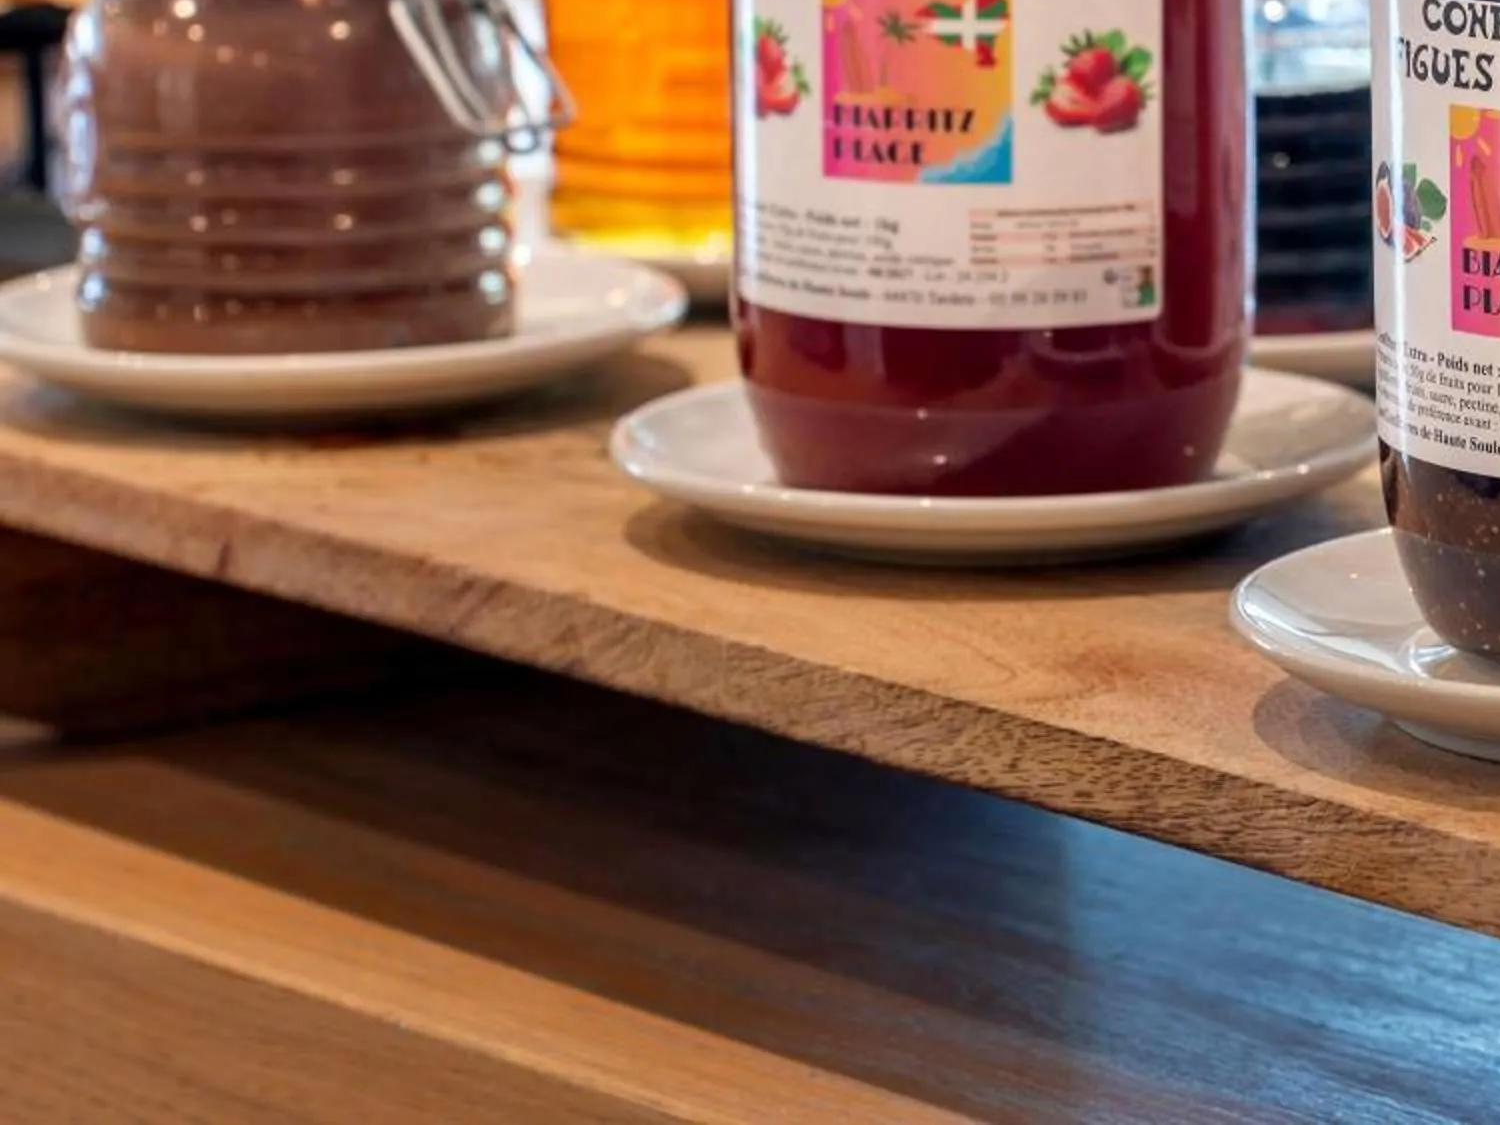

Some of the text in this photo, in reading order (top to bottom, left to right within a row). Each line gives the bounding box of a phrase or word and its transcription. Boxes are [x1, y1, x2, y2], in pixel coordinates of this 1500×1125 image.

[1437, 351, 1469, 373] Poids
[1473, 363, 1494, 376] net
[1467, 381, 1493, 396] pour
[1433, 428, 1467, 450] Haute
